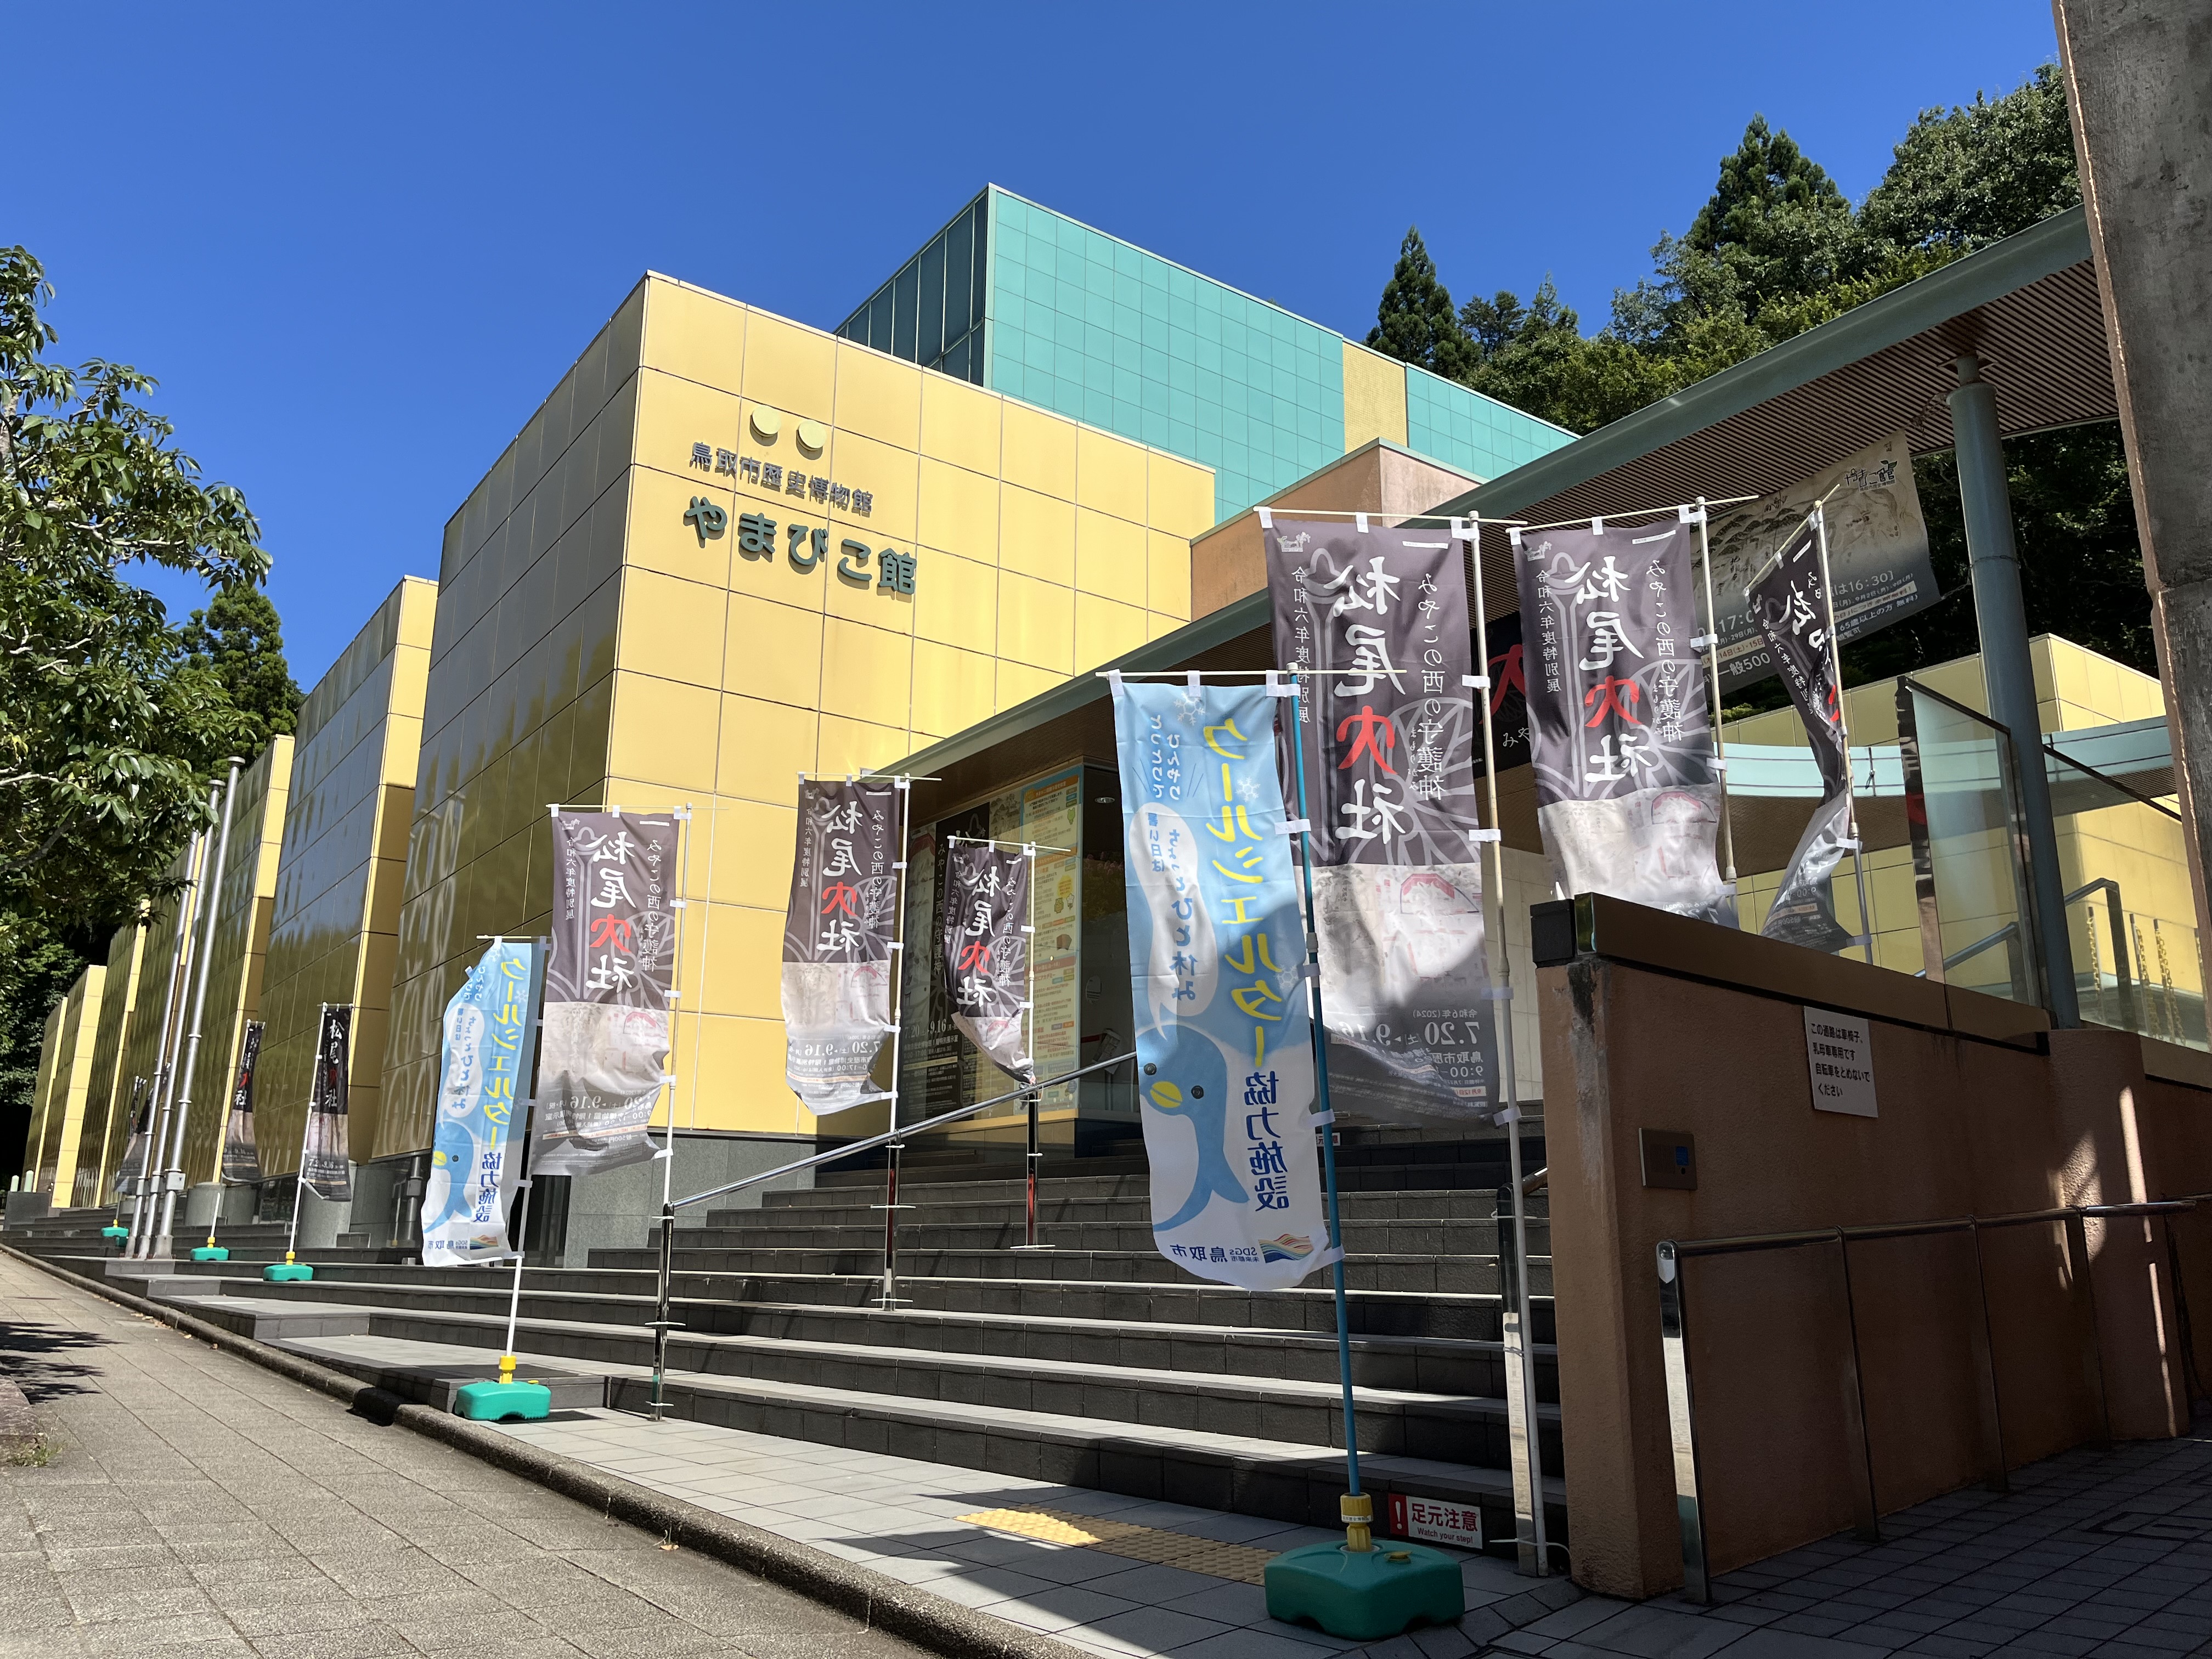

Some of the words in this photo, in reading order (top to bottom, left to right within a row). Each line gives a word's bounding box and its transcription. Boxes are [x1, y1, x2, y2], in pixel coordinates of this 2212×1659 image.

[689, 441, 873, 516] 鳥取市歴史博物館
[684, 495, 917, 597] やまびこ館
[930, 1018, 947, 1034] 9.16
[1810, 1022, 1863, 1044] この通路は車椅子、
[1812, 1042, 1856, 1062] 乳母車専用です
[1815, 1062, 1871, 1082] 自転車をとめないで
[1818, 1082, 1843, 1097] ください
[1411, 1502, 1478, 1532] 足元注意
[1417, 1527, 1438, 1538] Watch
[1440, 1531, 1455, 1541] your
[1456, 1534, 1474, 1545] step!
